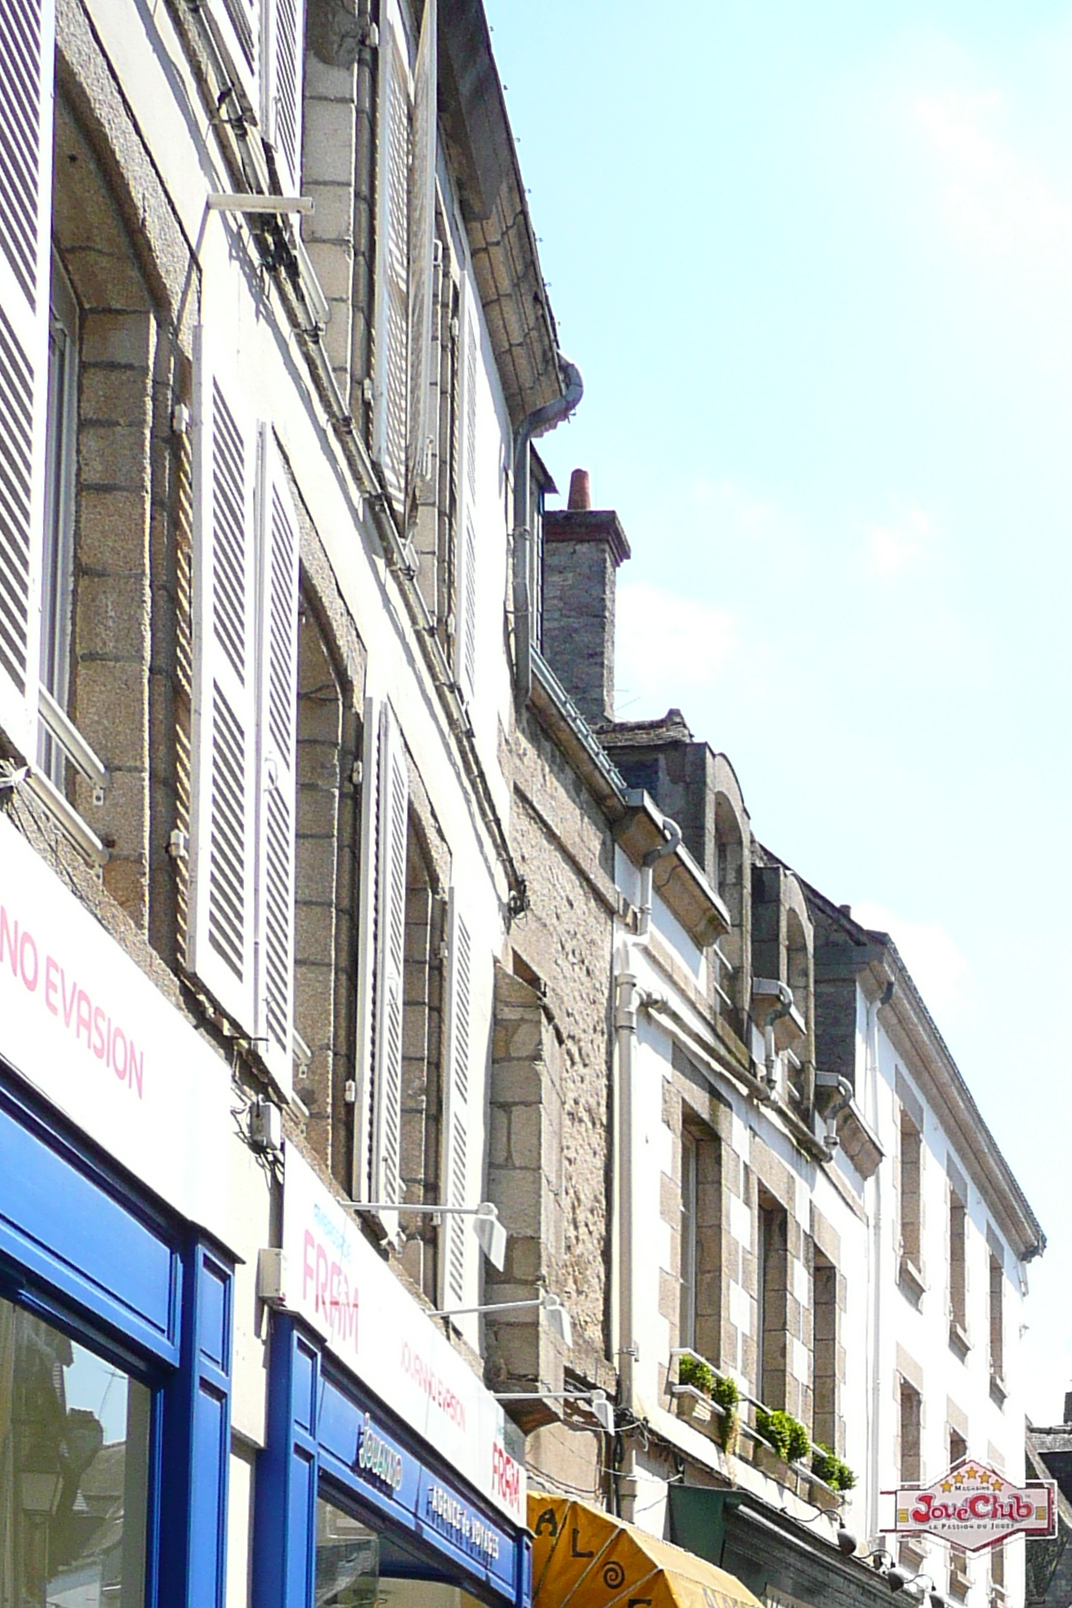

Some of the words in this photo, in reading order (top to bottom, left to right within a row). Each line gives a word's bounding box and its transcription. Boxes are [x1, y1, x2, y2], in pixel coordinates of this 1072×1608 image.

[45, 955, 144, 1100] EVASION
[303, 1228, 359, 1355] FRAM
[431, 1485, 461, 1531] AGENCE
[492, 1441, 520, 1514] FRAM
